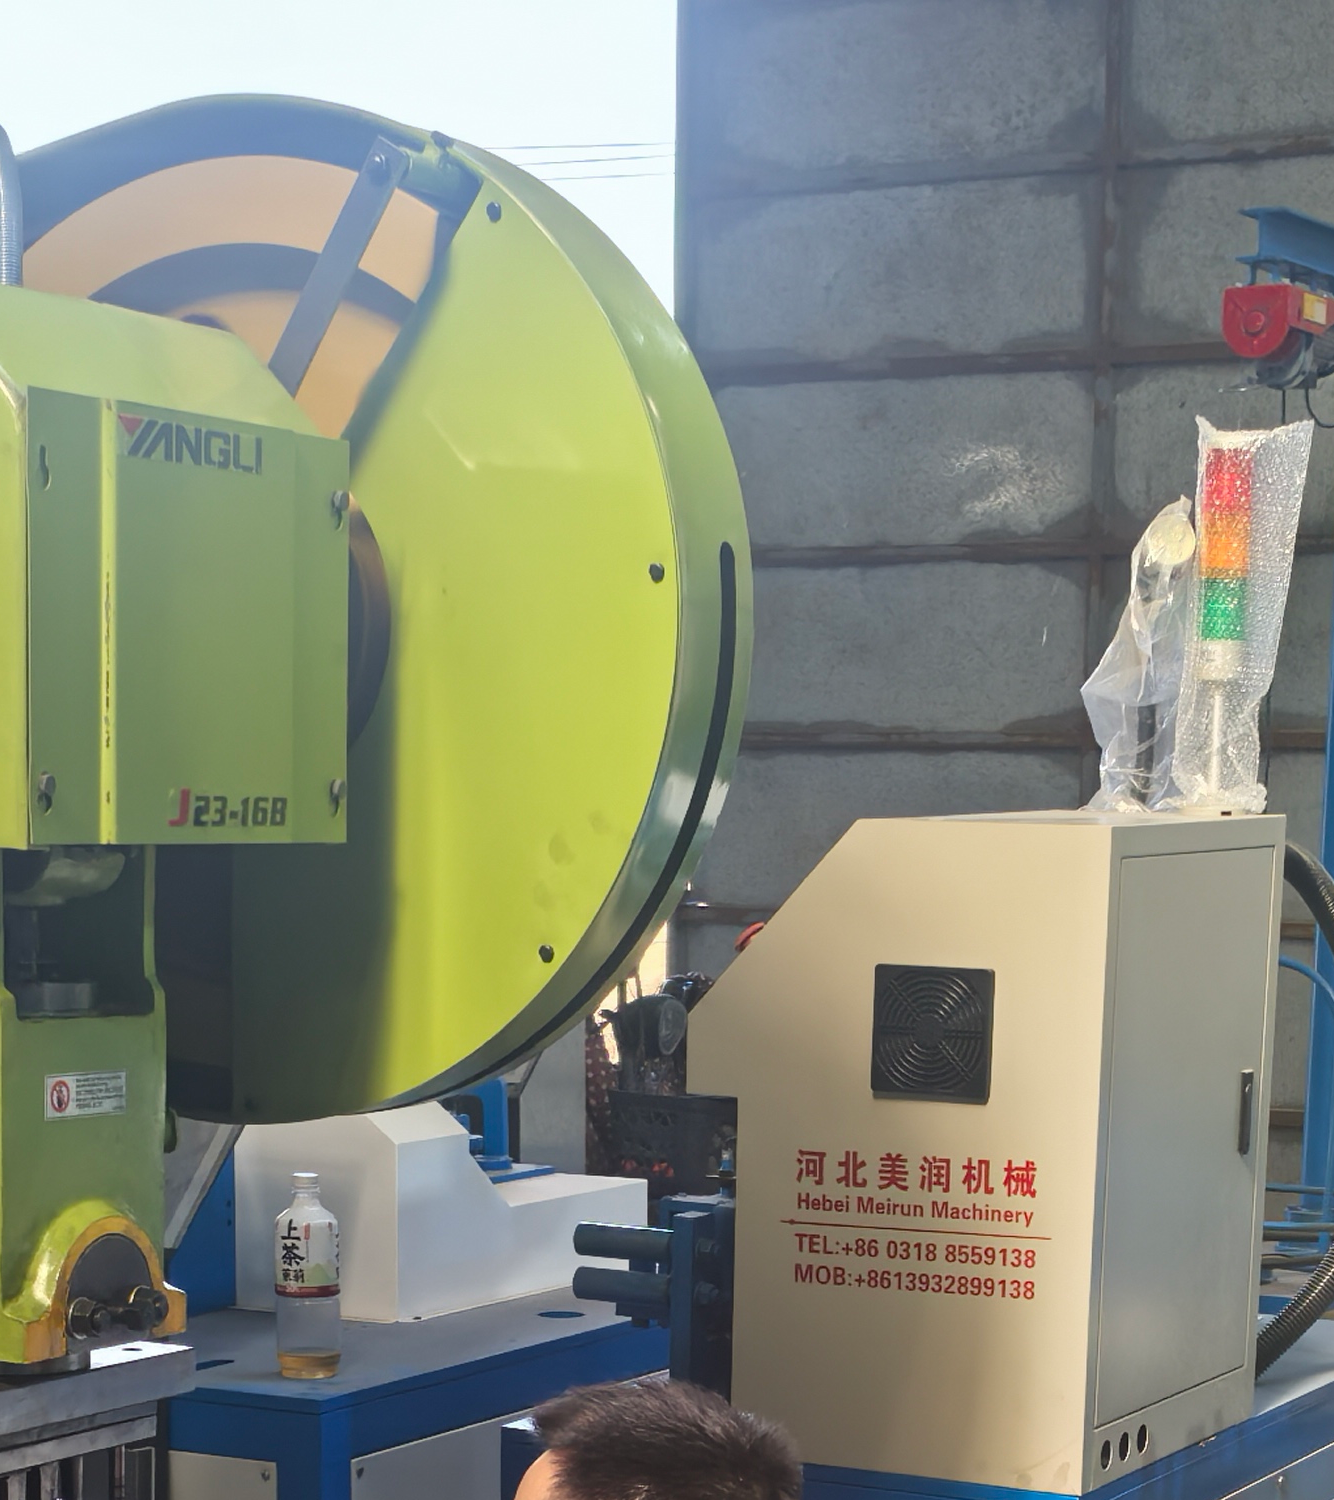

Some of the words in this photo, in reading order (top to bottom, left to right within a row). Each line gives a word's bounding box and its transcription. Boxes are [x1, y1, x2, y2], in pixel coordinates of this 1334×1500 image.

[118, 413, 263, 475] YANGLI
[795, 1149, 1038, 1199] 河北美润机械
[797, 1192, 850, 1214] Hebei
[856, 1196, 924, 1218] Meirun
[931, 1201, 1034, 1228] Machinery
[794, 1233, 880, 1258] TEL:+86
[886, 1239, 938, 1262] 0318
[944, 1244, 1037, 1269] 8559138
[794, 1263, 1036, 1301] MOB:+8613932899138
